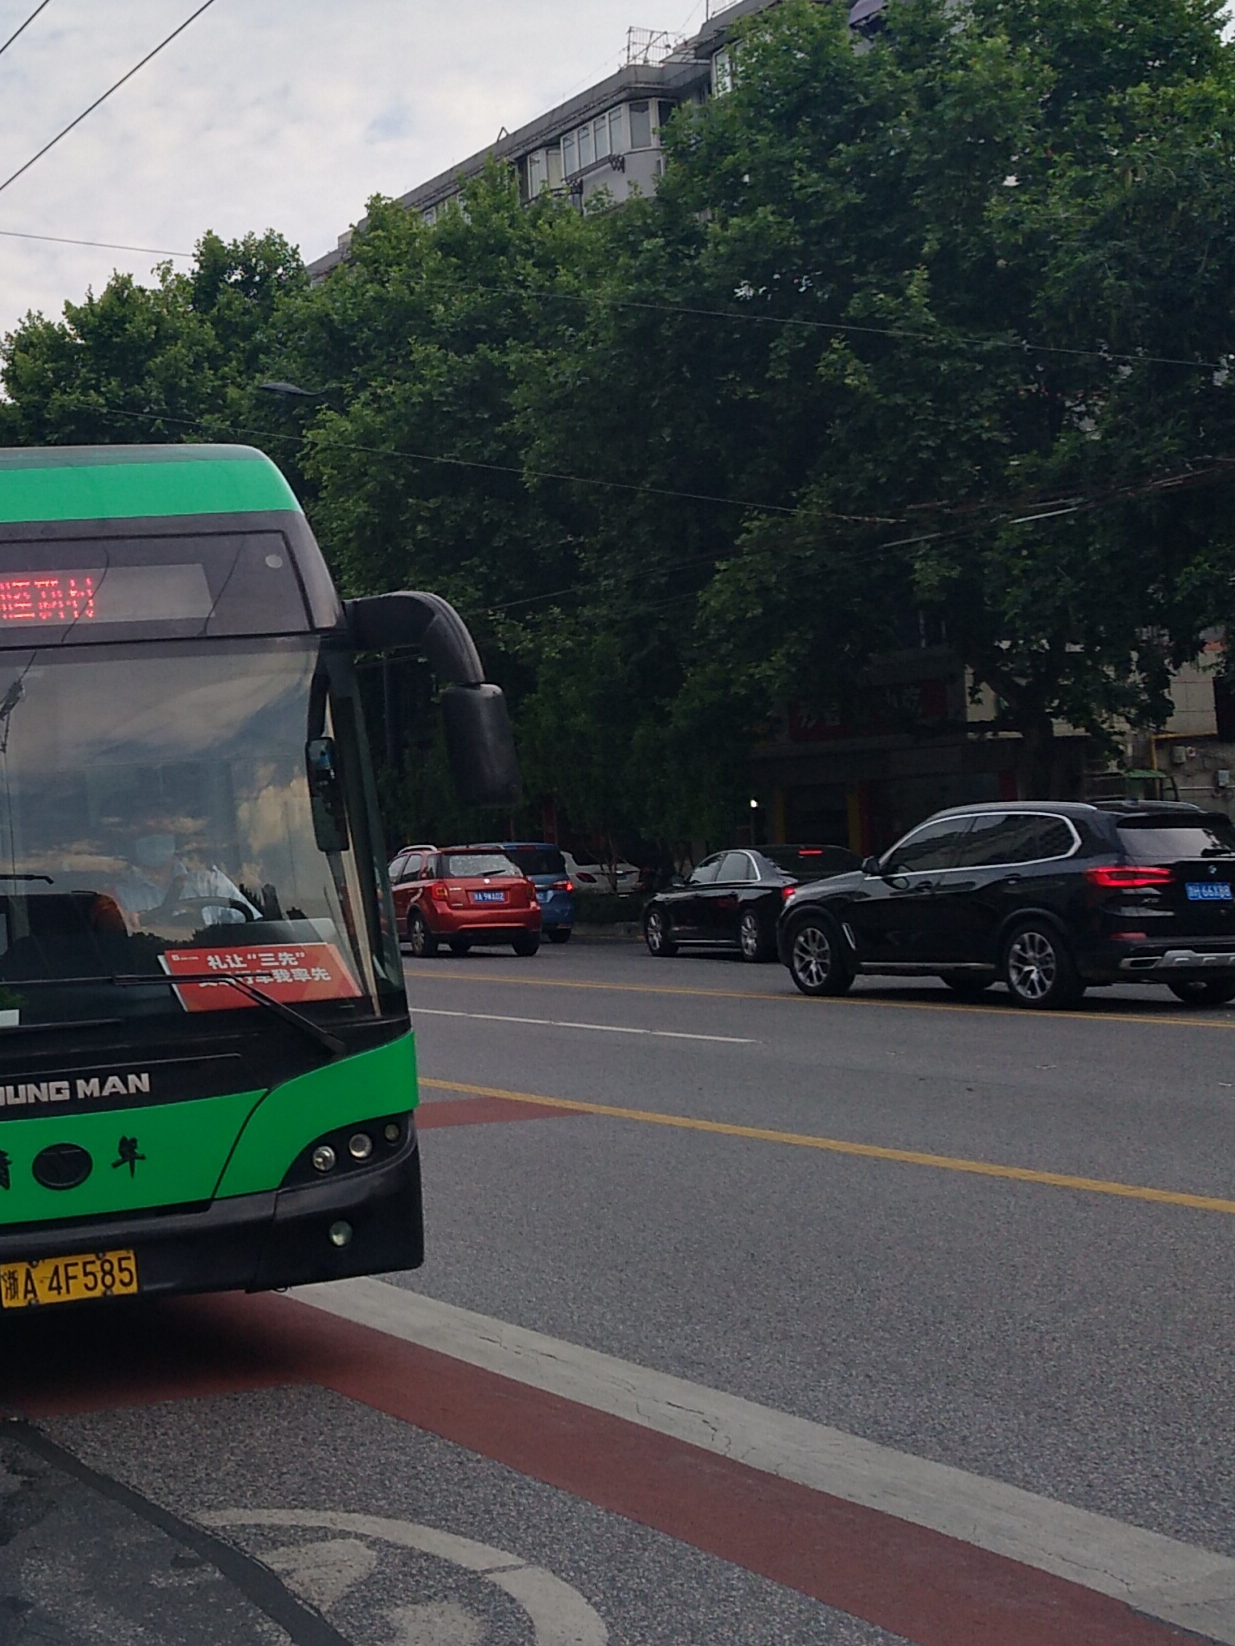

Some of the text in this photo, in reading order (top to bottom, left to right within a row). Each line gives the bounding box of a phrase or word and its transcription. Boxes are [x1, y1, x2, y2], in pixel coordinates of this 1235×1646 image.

[198, 967, 332, 988] 行车我率先
[76, 1073, 151, 1099] MAN
